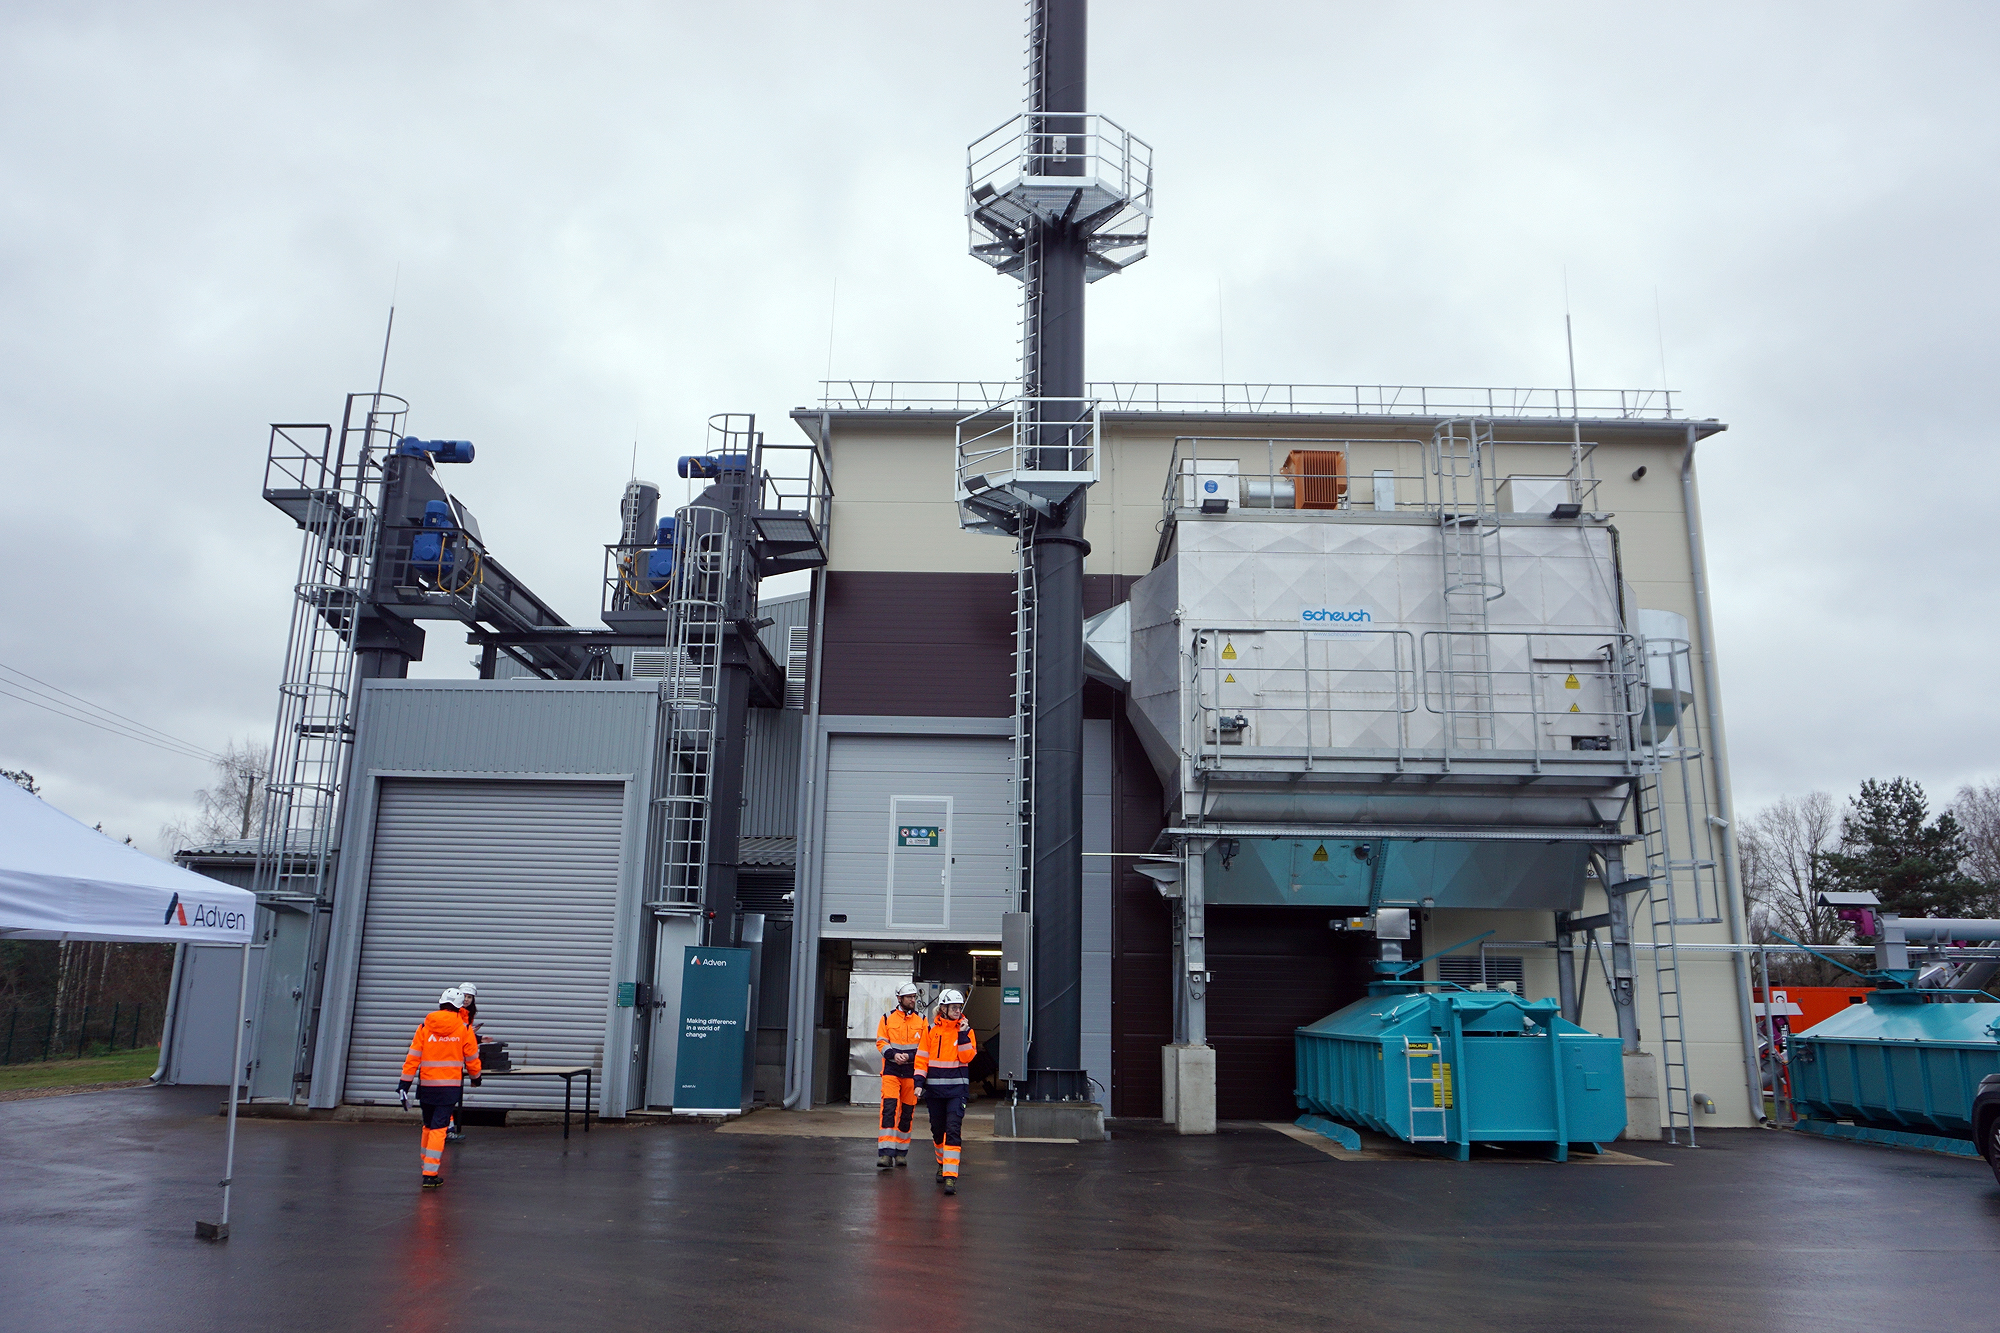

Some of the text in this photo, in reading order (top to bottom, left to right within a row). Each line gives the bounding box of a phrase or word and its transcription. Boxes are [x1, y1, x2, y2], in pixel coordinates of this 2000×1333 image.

[1302, 608, 1371, 621] scheuch
[193, 904, 246, 930] Adven
[702, 959, 727, 967] Adven
